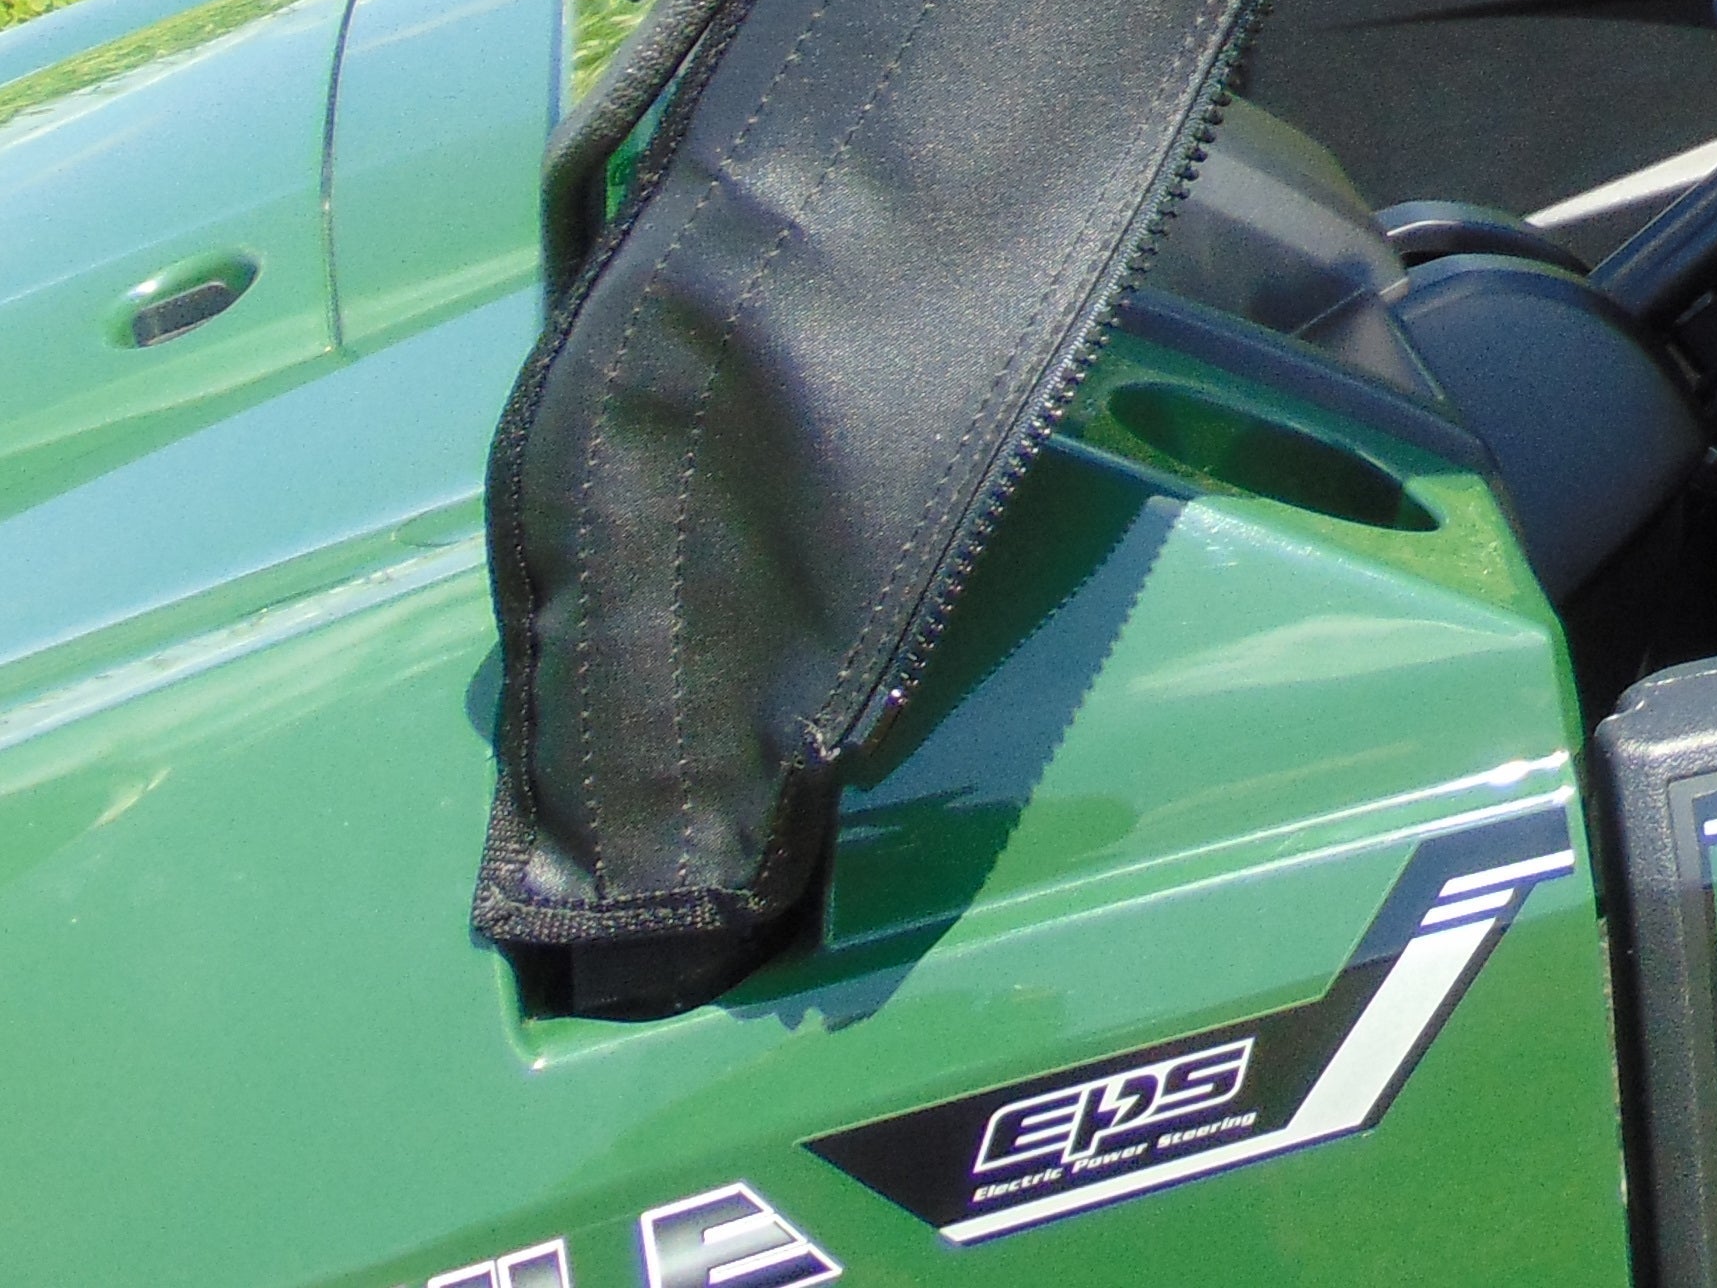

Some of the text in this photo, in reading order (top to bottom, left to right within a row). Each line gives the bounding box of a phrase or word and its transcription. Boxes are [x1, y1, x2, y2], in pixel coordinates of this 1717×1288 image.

[972, 1112, 1257, 1202] Electric Power Steering
[973, 1037, 1255, 1173] EPS
